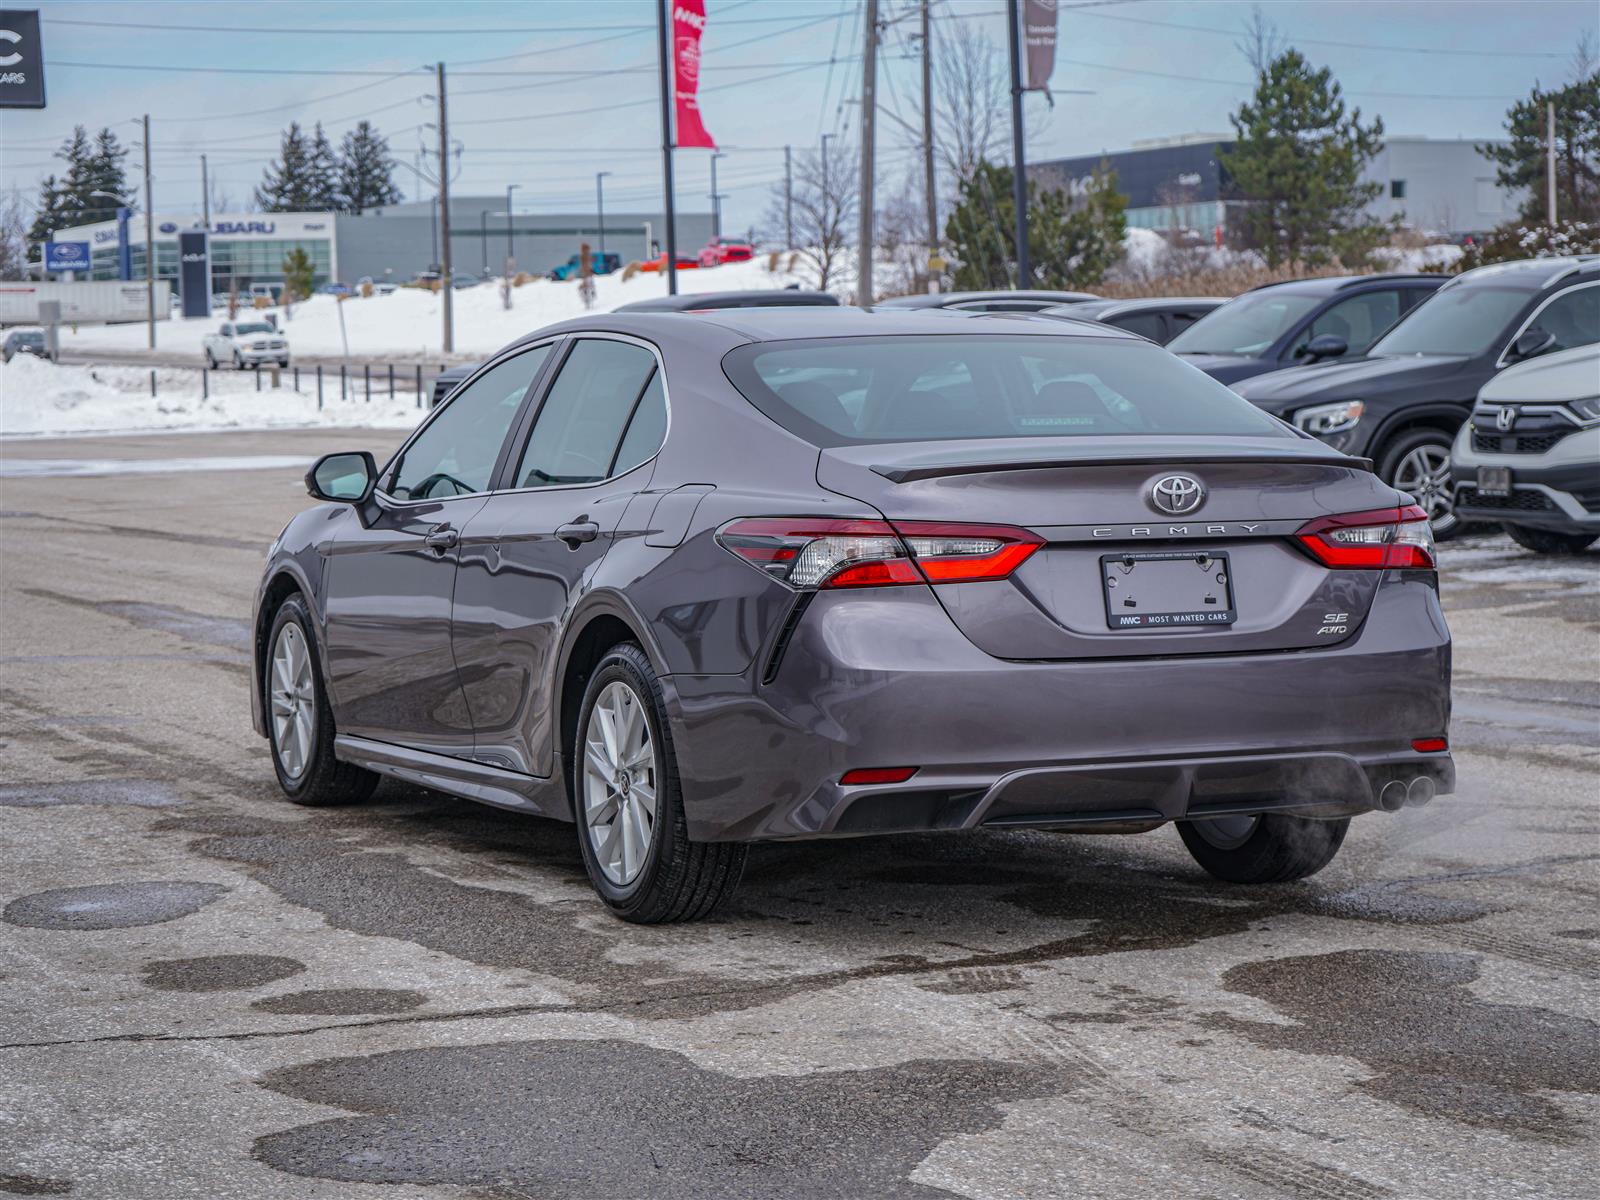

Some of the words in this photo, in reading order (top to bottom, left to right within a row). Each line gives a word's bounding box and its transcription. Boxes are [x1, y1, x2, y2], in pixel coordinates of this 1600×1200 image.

[0, 72, 26, 84] ARS
[1092, 524, 1259, 537] CAMRY
[1120, 616, 1141, 625] MWC
[1148, 615, 1170, 623] MOST
[1173, 614, 1205, 622] WANTED
[1208, 613, 1227, 621] CARS
[1322, 613, 1349, 624] SE
[1316, 625, 1347, 635] AWD
